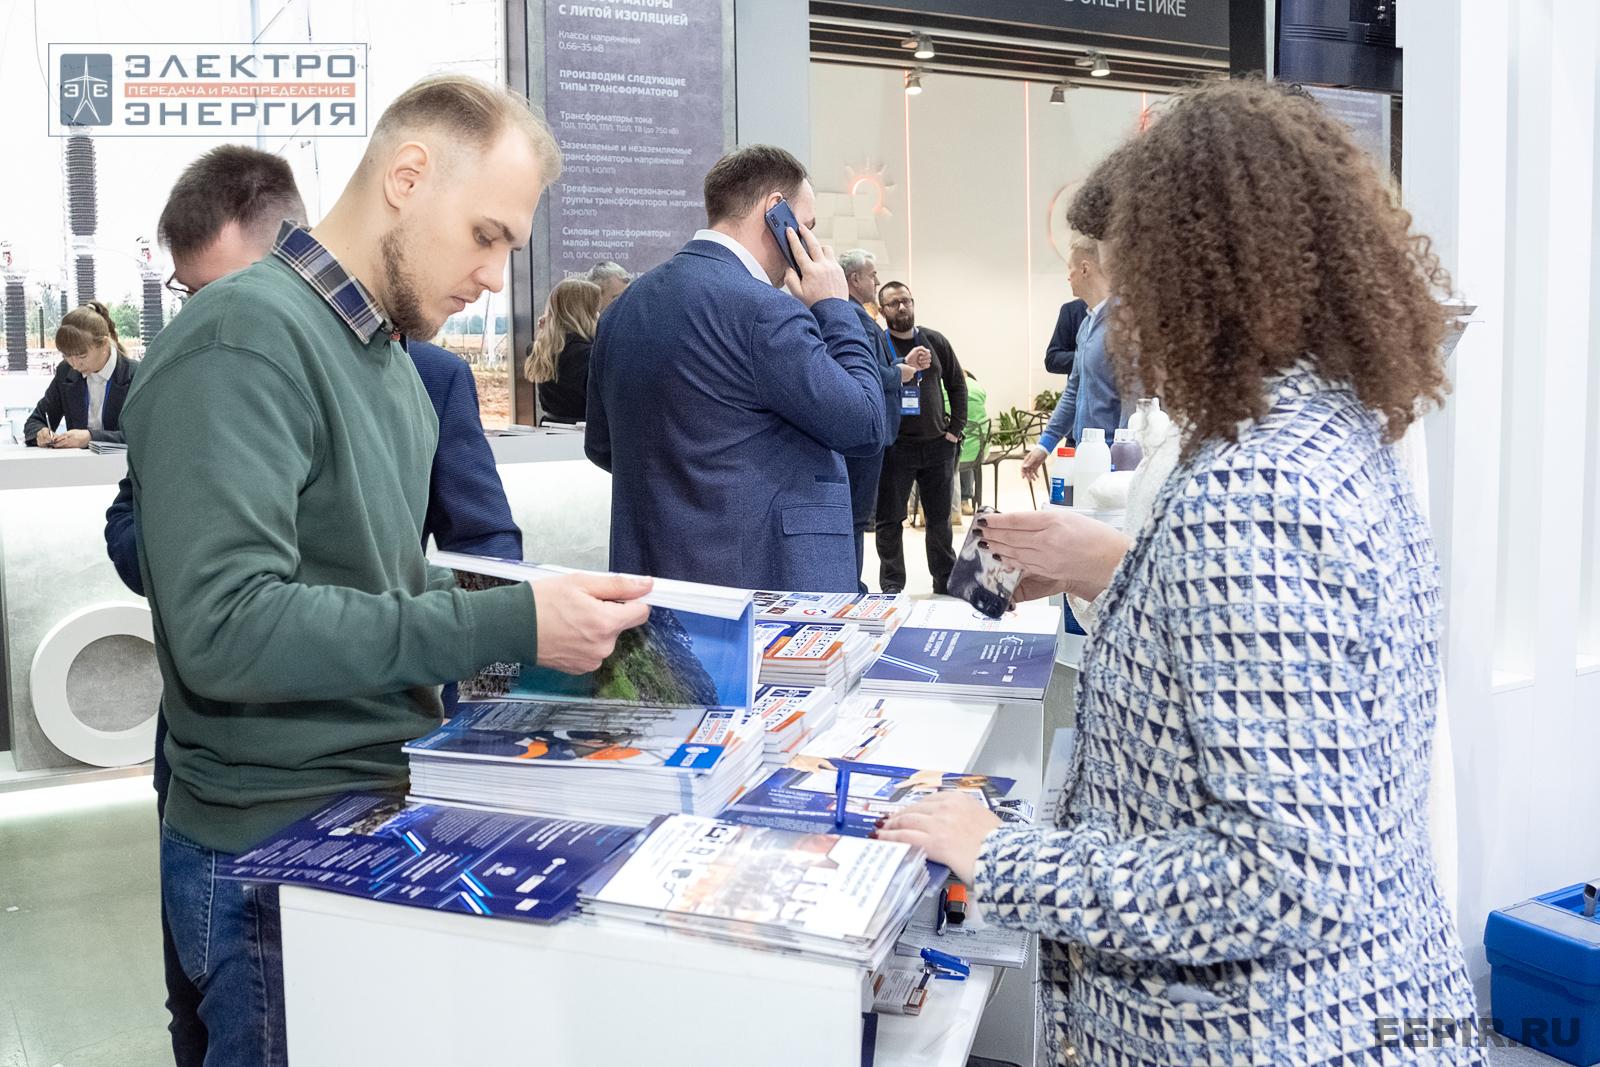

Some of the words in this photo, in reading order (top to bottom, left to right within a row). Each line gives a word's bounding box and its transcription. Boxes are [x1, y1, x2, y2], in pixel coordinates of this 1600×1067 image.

[558, 4, 567, 15] С
[569, 5, 612, 19] ЛИТОЙ
[614, 9, 689, 26] ИЗОЛЯЦИЕЙ
[558, 30, 589, 41] Классы
[590, 34, 641, 45] напряжения
[559, 69, 625, 82] ПРОИЗВОДИМ
[627, 74, 687, 87] СЛЕДУЮЩИЕ
[559, 82, 588, 92] ТИПЫ
[589, 83, 679, 97] ТРАНСФОРМАТОРОВ
[560, 111, 633, 124] Трансформаторы
[634, 116, 653, 124] тока
[560, 140, 619, 151] Заземляемые
[628, 144, 693, 155] незаземляемые
[560, 153, 633, 164] трансформаторы
[634, 156, 685, 166] напряжения
[561, 184, 613, 194] Трехфазные
[561, 196, 593, 205] группы
[594, 198, 668, 208] трансформаторов
[562, 227, 600, 236] Силовые
[601, 228, 671, 239] трансформаторы
[562, 238, 590, 247] малой
[591, 240, 634, 249] мощности
